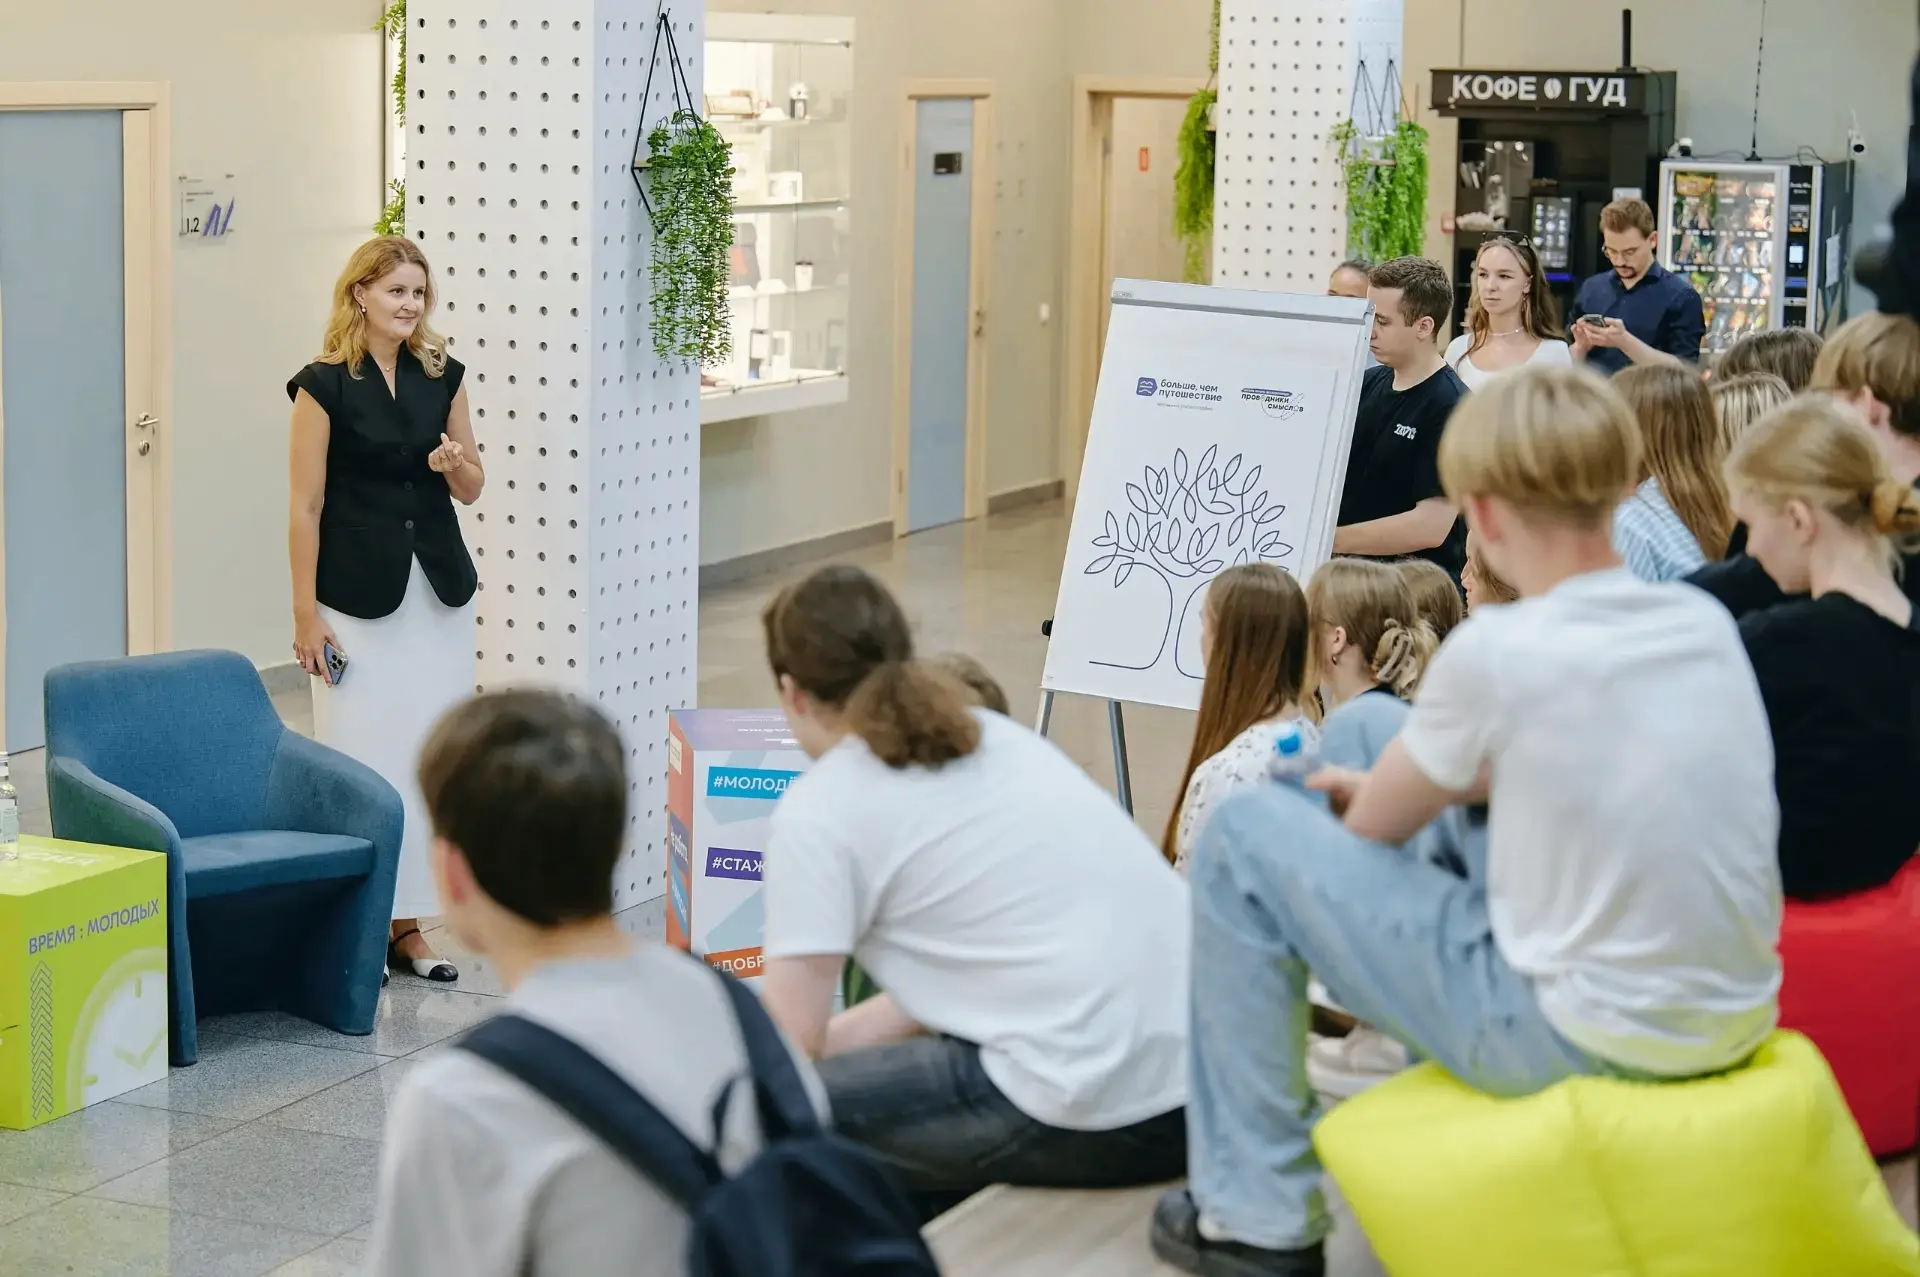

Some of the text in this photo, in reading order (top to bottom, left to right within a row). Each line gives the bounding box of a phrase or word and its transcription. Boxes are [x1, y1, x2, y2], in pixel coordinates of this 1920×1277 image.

[1452, 74, 1627, 107] КОФЕ ГУД
[1158, 389, 1223, 402] путешествие
[1160, 379, 1219, 393] больше, чем
[28, 924, 76, 955] ВРЕМЯ
[87, 898, 160, 937] МОЛОДЫХ
